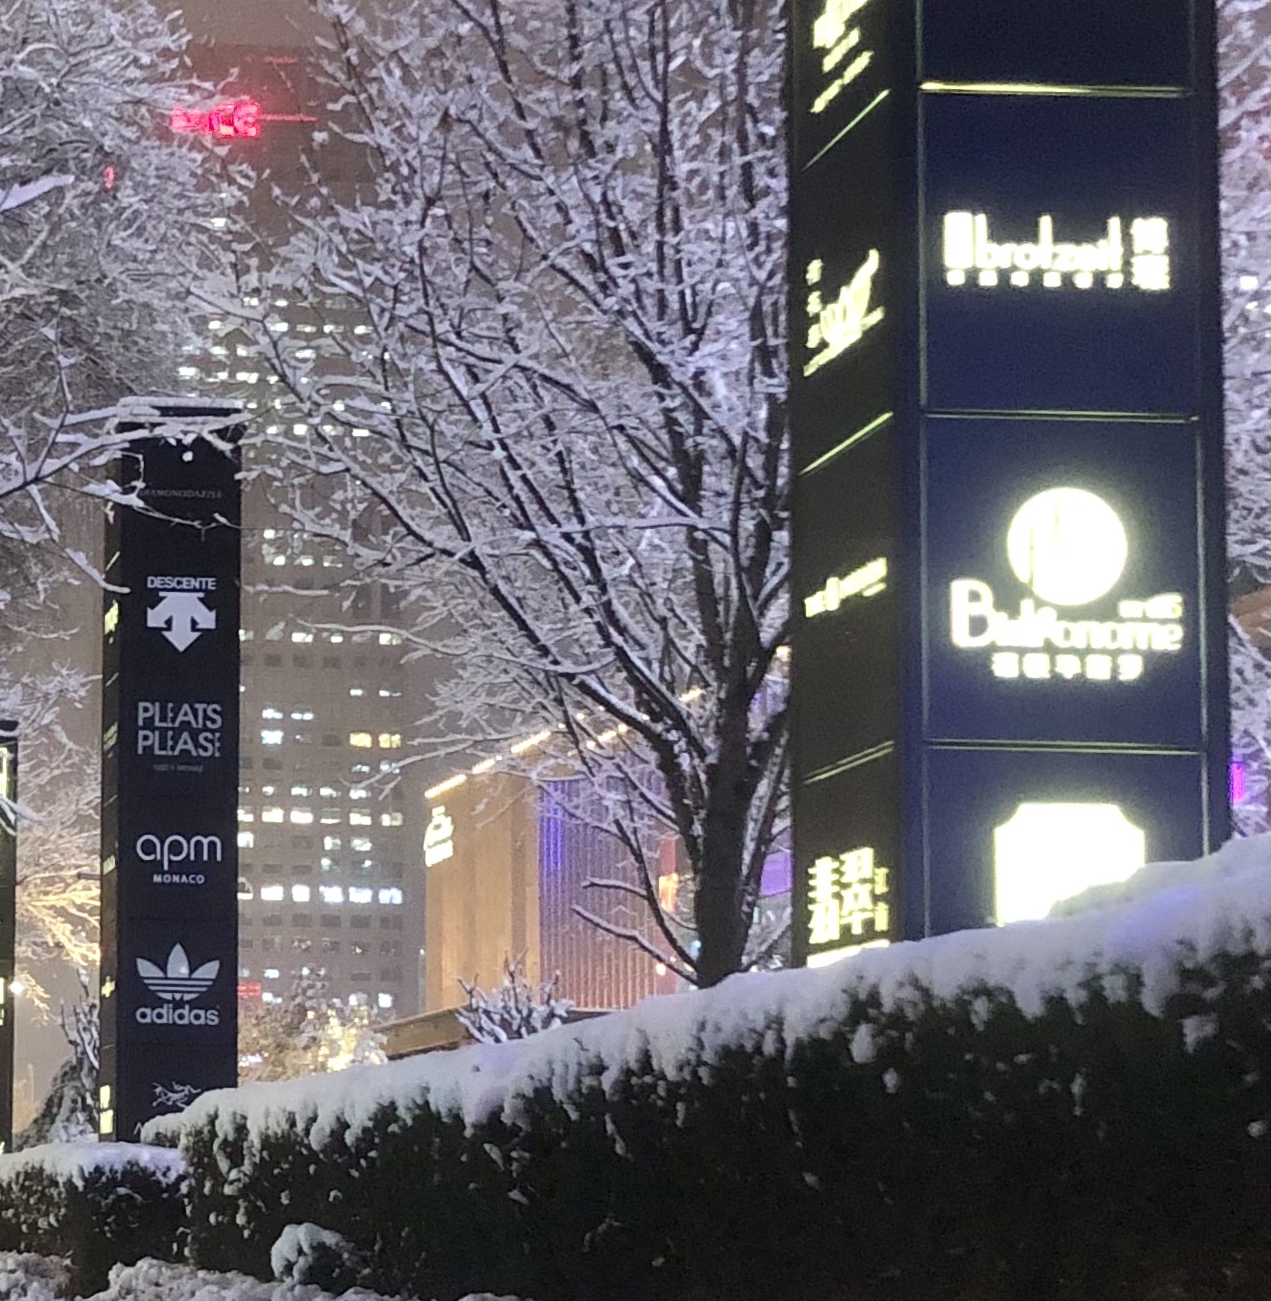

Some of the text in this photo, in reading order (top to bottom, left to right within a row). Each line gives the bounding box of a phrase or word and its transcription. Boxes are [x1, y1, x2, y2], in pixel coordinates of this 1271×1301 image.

[146, 576, 217, 590] DESCENTE
[137, 701, 223, 729] PLEATS
[137, 730, 222, 757] PLEASE
[136, 834, 222, 871] apm
[153, 874, 205, 885] MONACO
[135, 1004, 220, 1026] adidas
